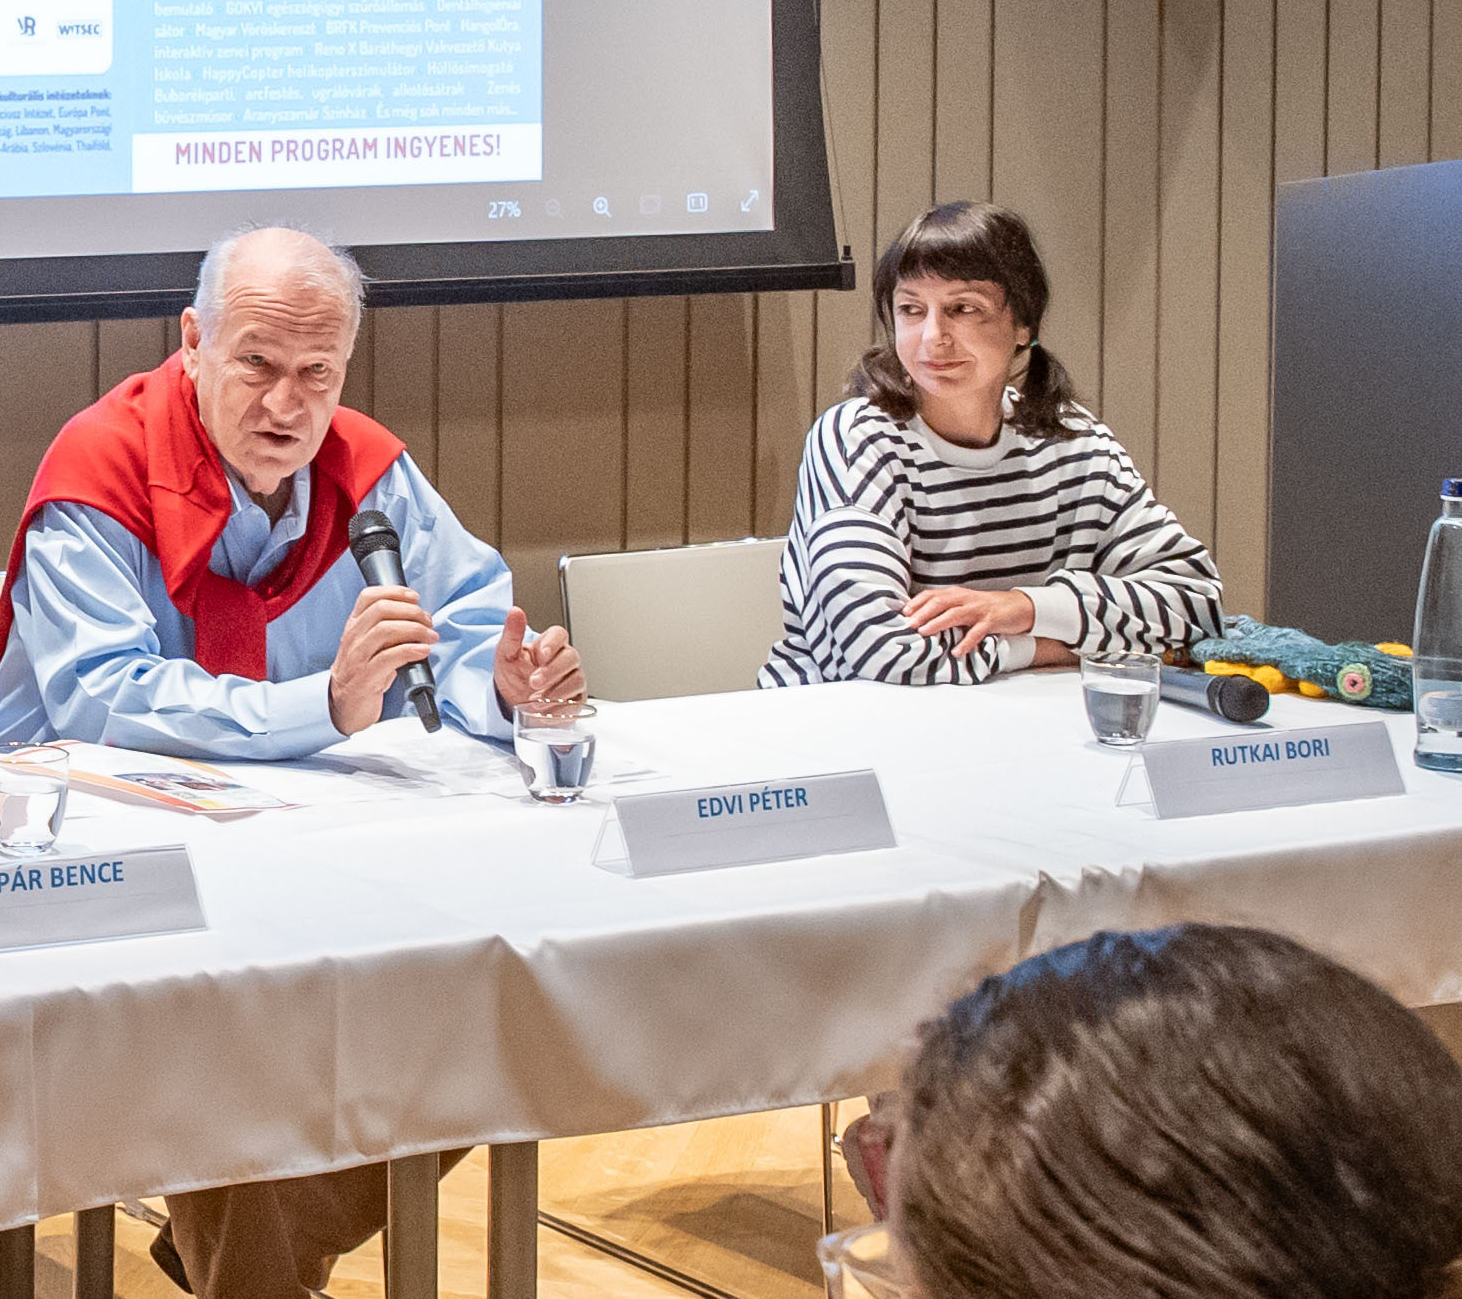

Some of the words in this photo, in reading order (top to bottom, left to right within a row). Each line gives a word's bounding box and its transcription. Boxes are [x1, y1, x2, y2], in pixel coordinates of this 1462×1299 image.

[174, 139, 264, 167] MINDEN
[269, 137, 379, 164] PROGRAM
[384, 133, 502, 162] INGYENES!
[487, 199, 522, 220] 27%
[1210, 741, 1281, 768] RUTKAI
[1284, 737, 1331, 762] BORI
[697, 794, 743, 819] EDVI
[748, 785, 809, 813] PÉTER
[49, 860, 125, 889] BENCE
